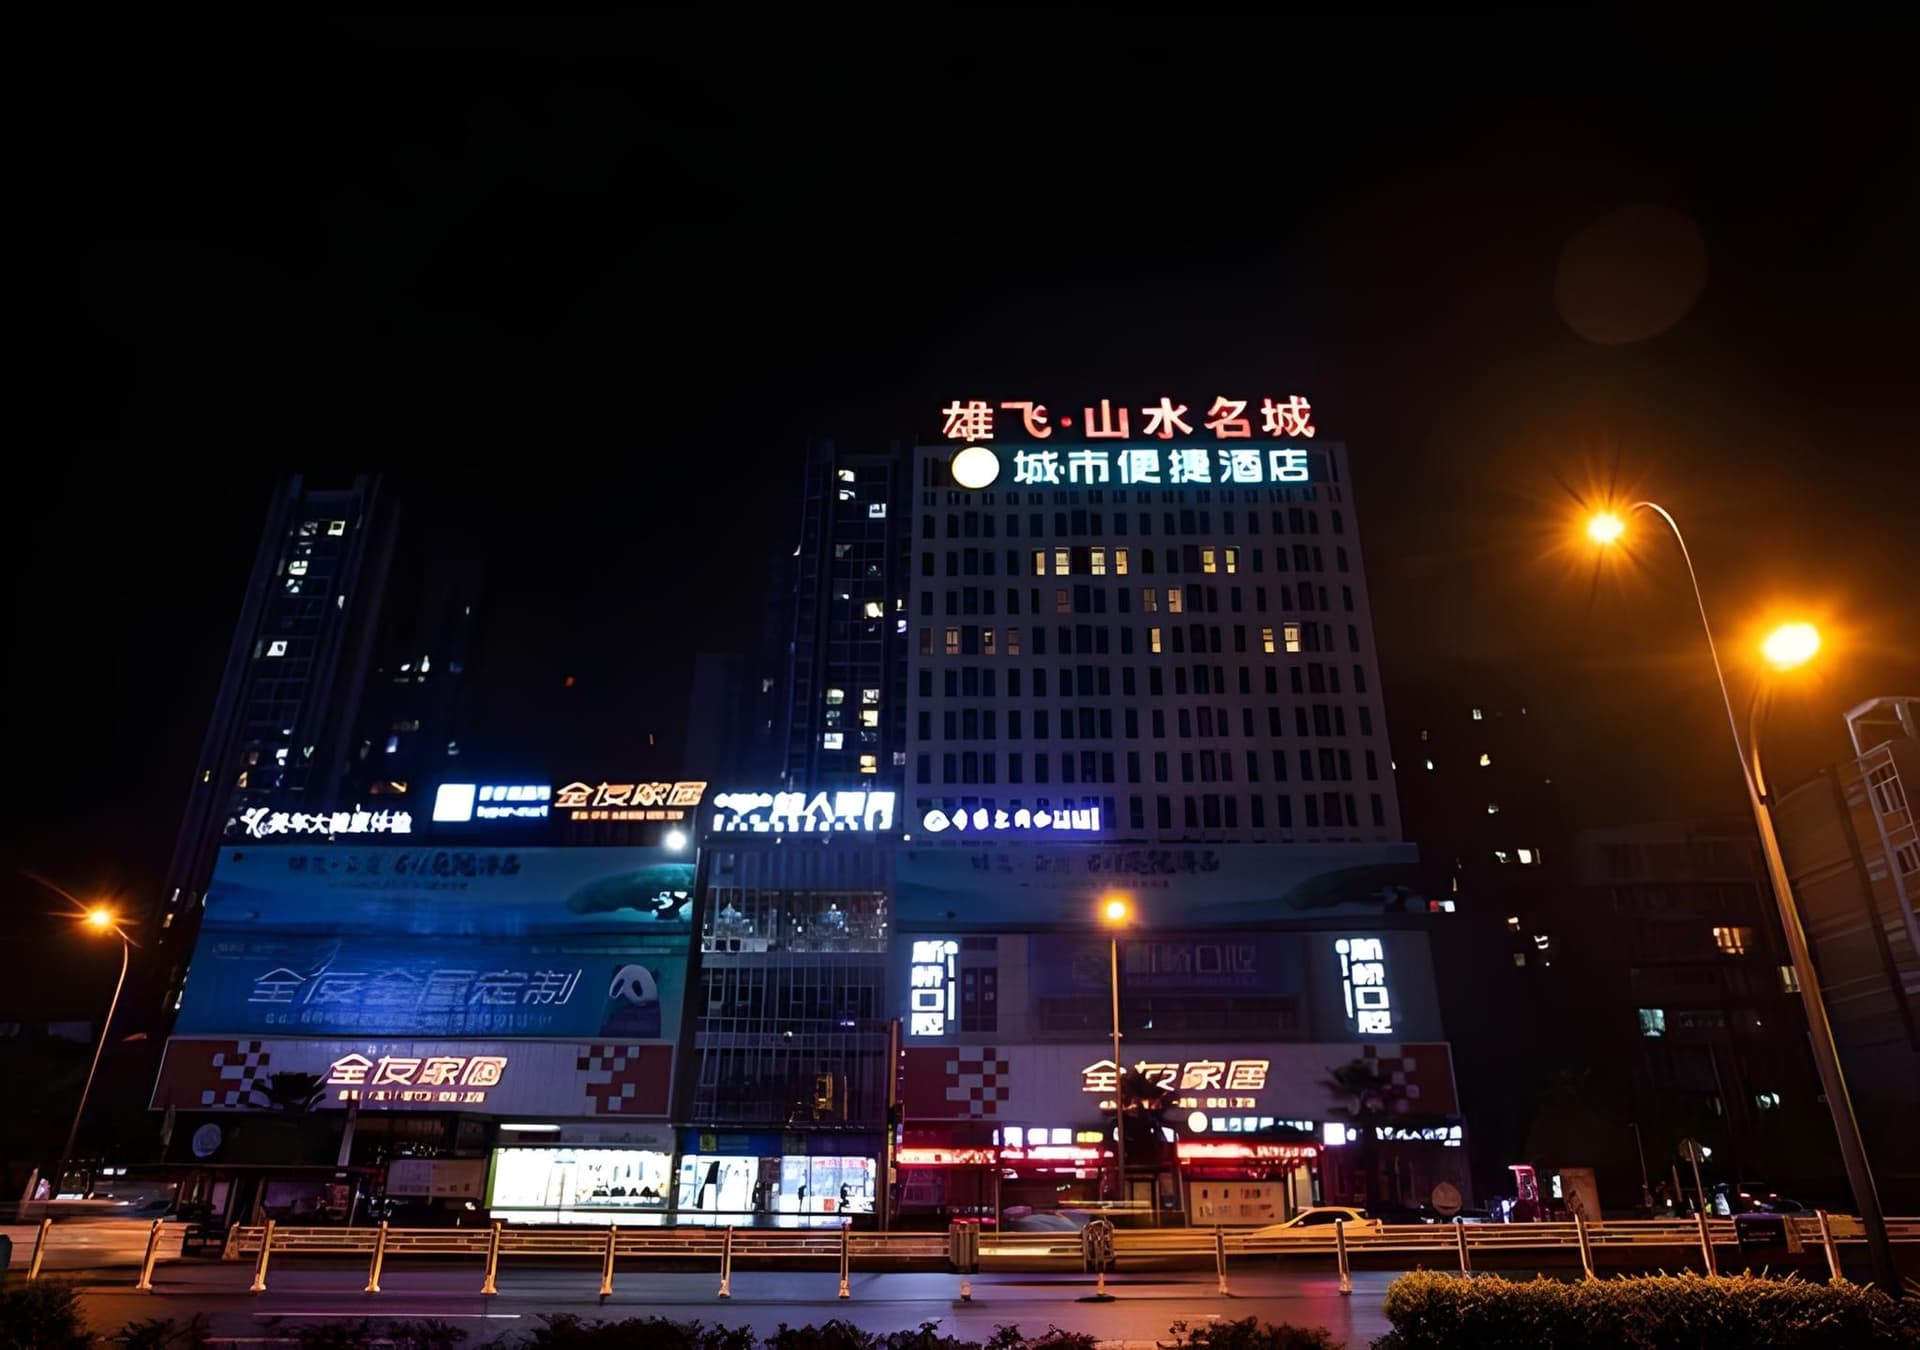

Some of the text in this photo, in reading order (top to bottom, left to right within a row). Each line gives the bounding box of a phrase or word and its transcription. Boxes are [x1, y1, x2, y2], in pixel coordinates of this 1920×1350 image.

[942, 396, 1315, 441] 雄飞·山水名城
[1013, 448, 1310, 485] 城市便捷酒店
[326, 1053, 508, 1086] 全友家居
